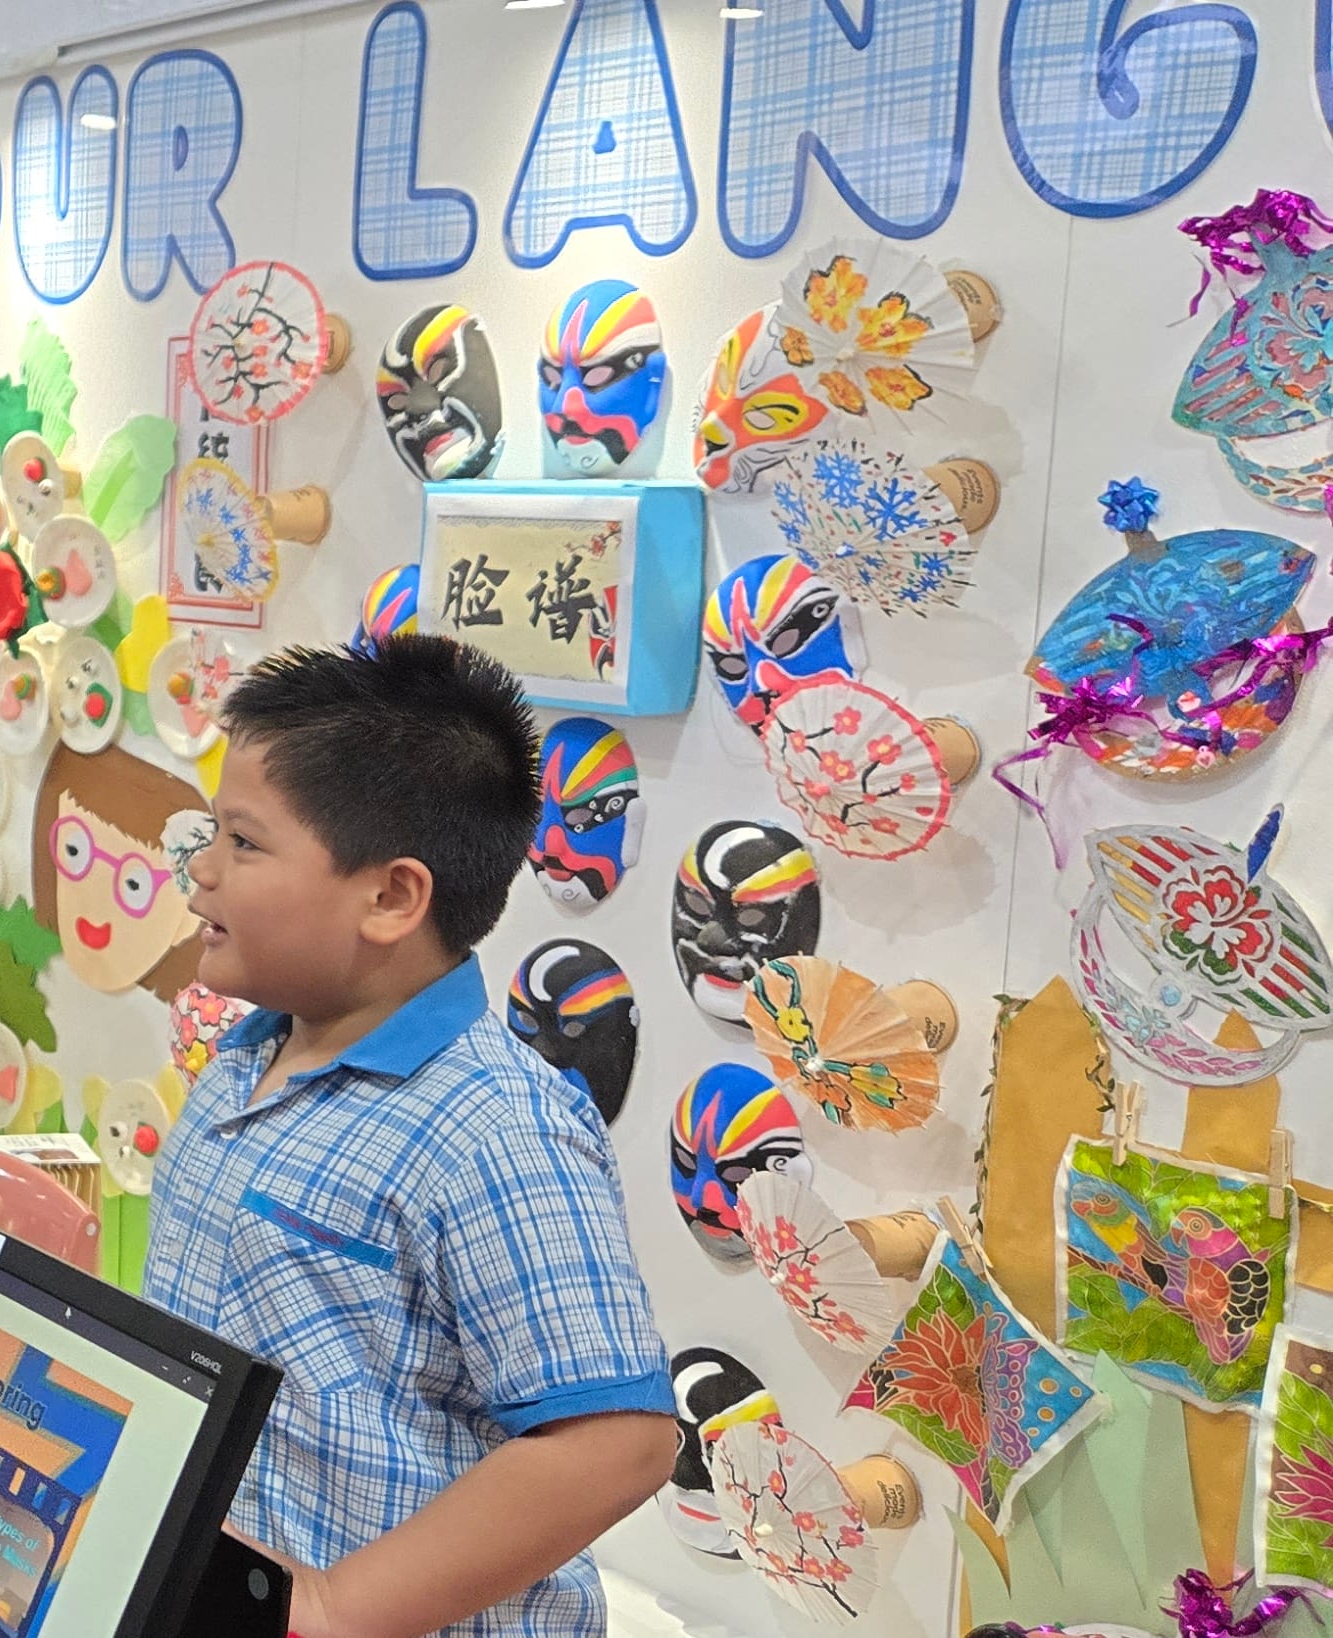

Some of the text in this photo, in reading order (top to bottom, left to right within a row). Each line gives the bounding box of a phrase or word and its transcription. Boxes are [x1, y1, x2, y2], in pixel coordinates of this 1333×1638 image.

[352, 0, 1333, 282] LANG
[440, 553, 597, 645] 脸谱
[25, 1536, 40, 1550] of
